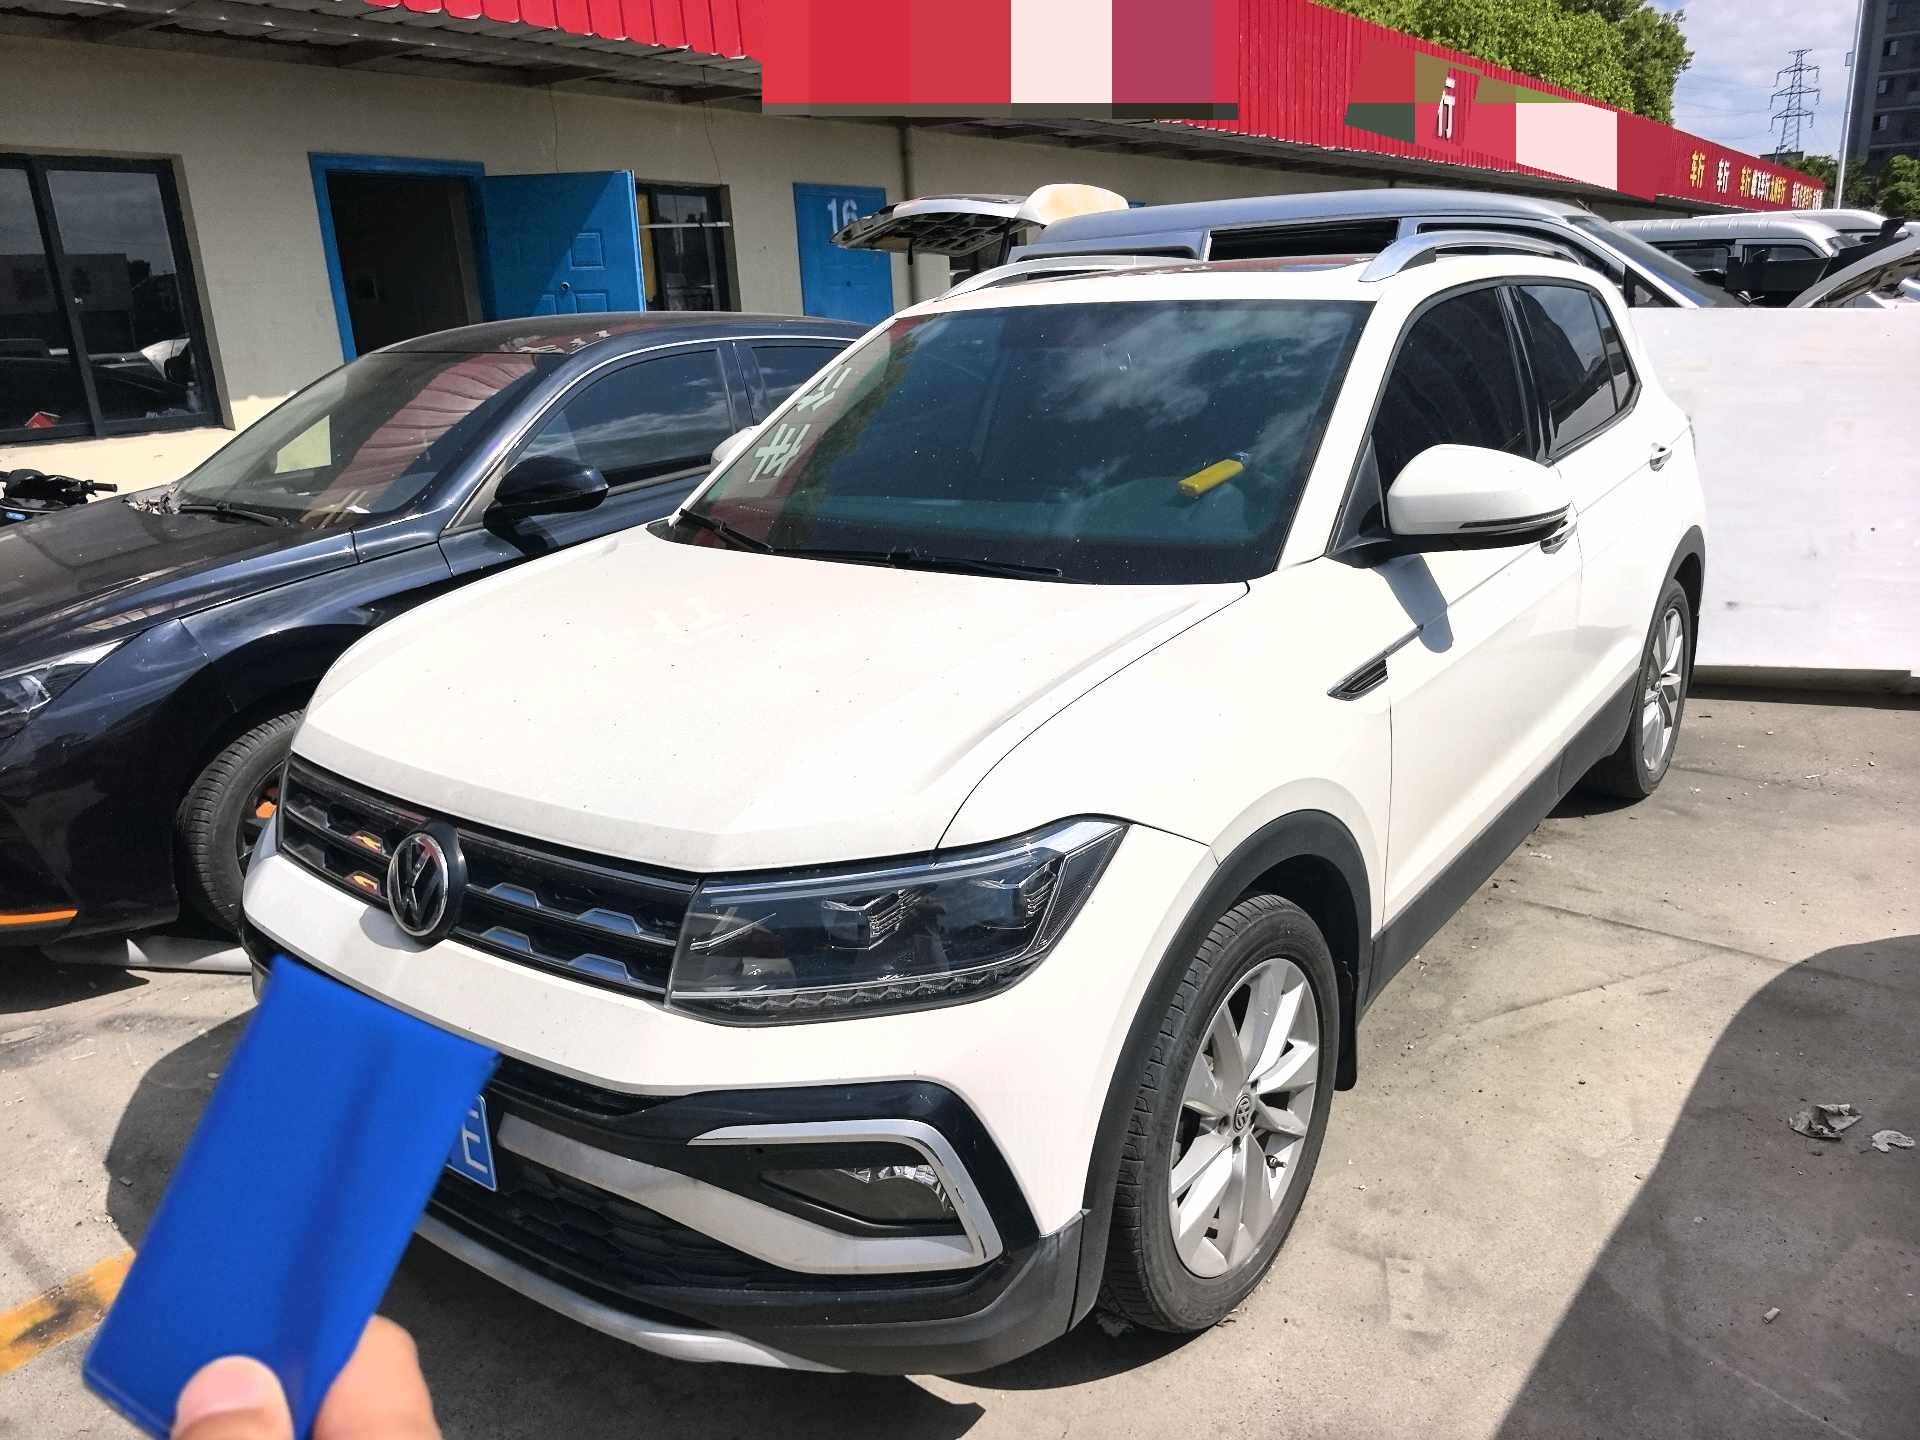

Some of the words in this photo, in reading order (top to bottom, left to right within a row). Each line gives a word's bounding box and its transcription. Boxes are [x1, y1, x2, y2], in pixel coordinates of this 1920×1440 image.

[1689, 150, 1706, 189] 车行
[1716, 158, 1731, 194] 车行
[827, 198, 858, 233] 16
